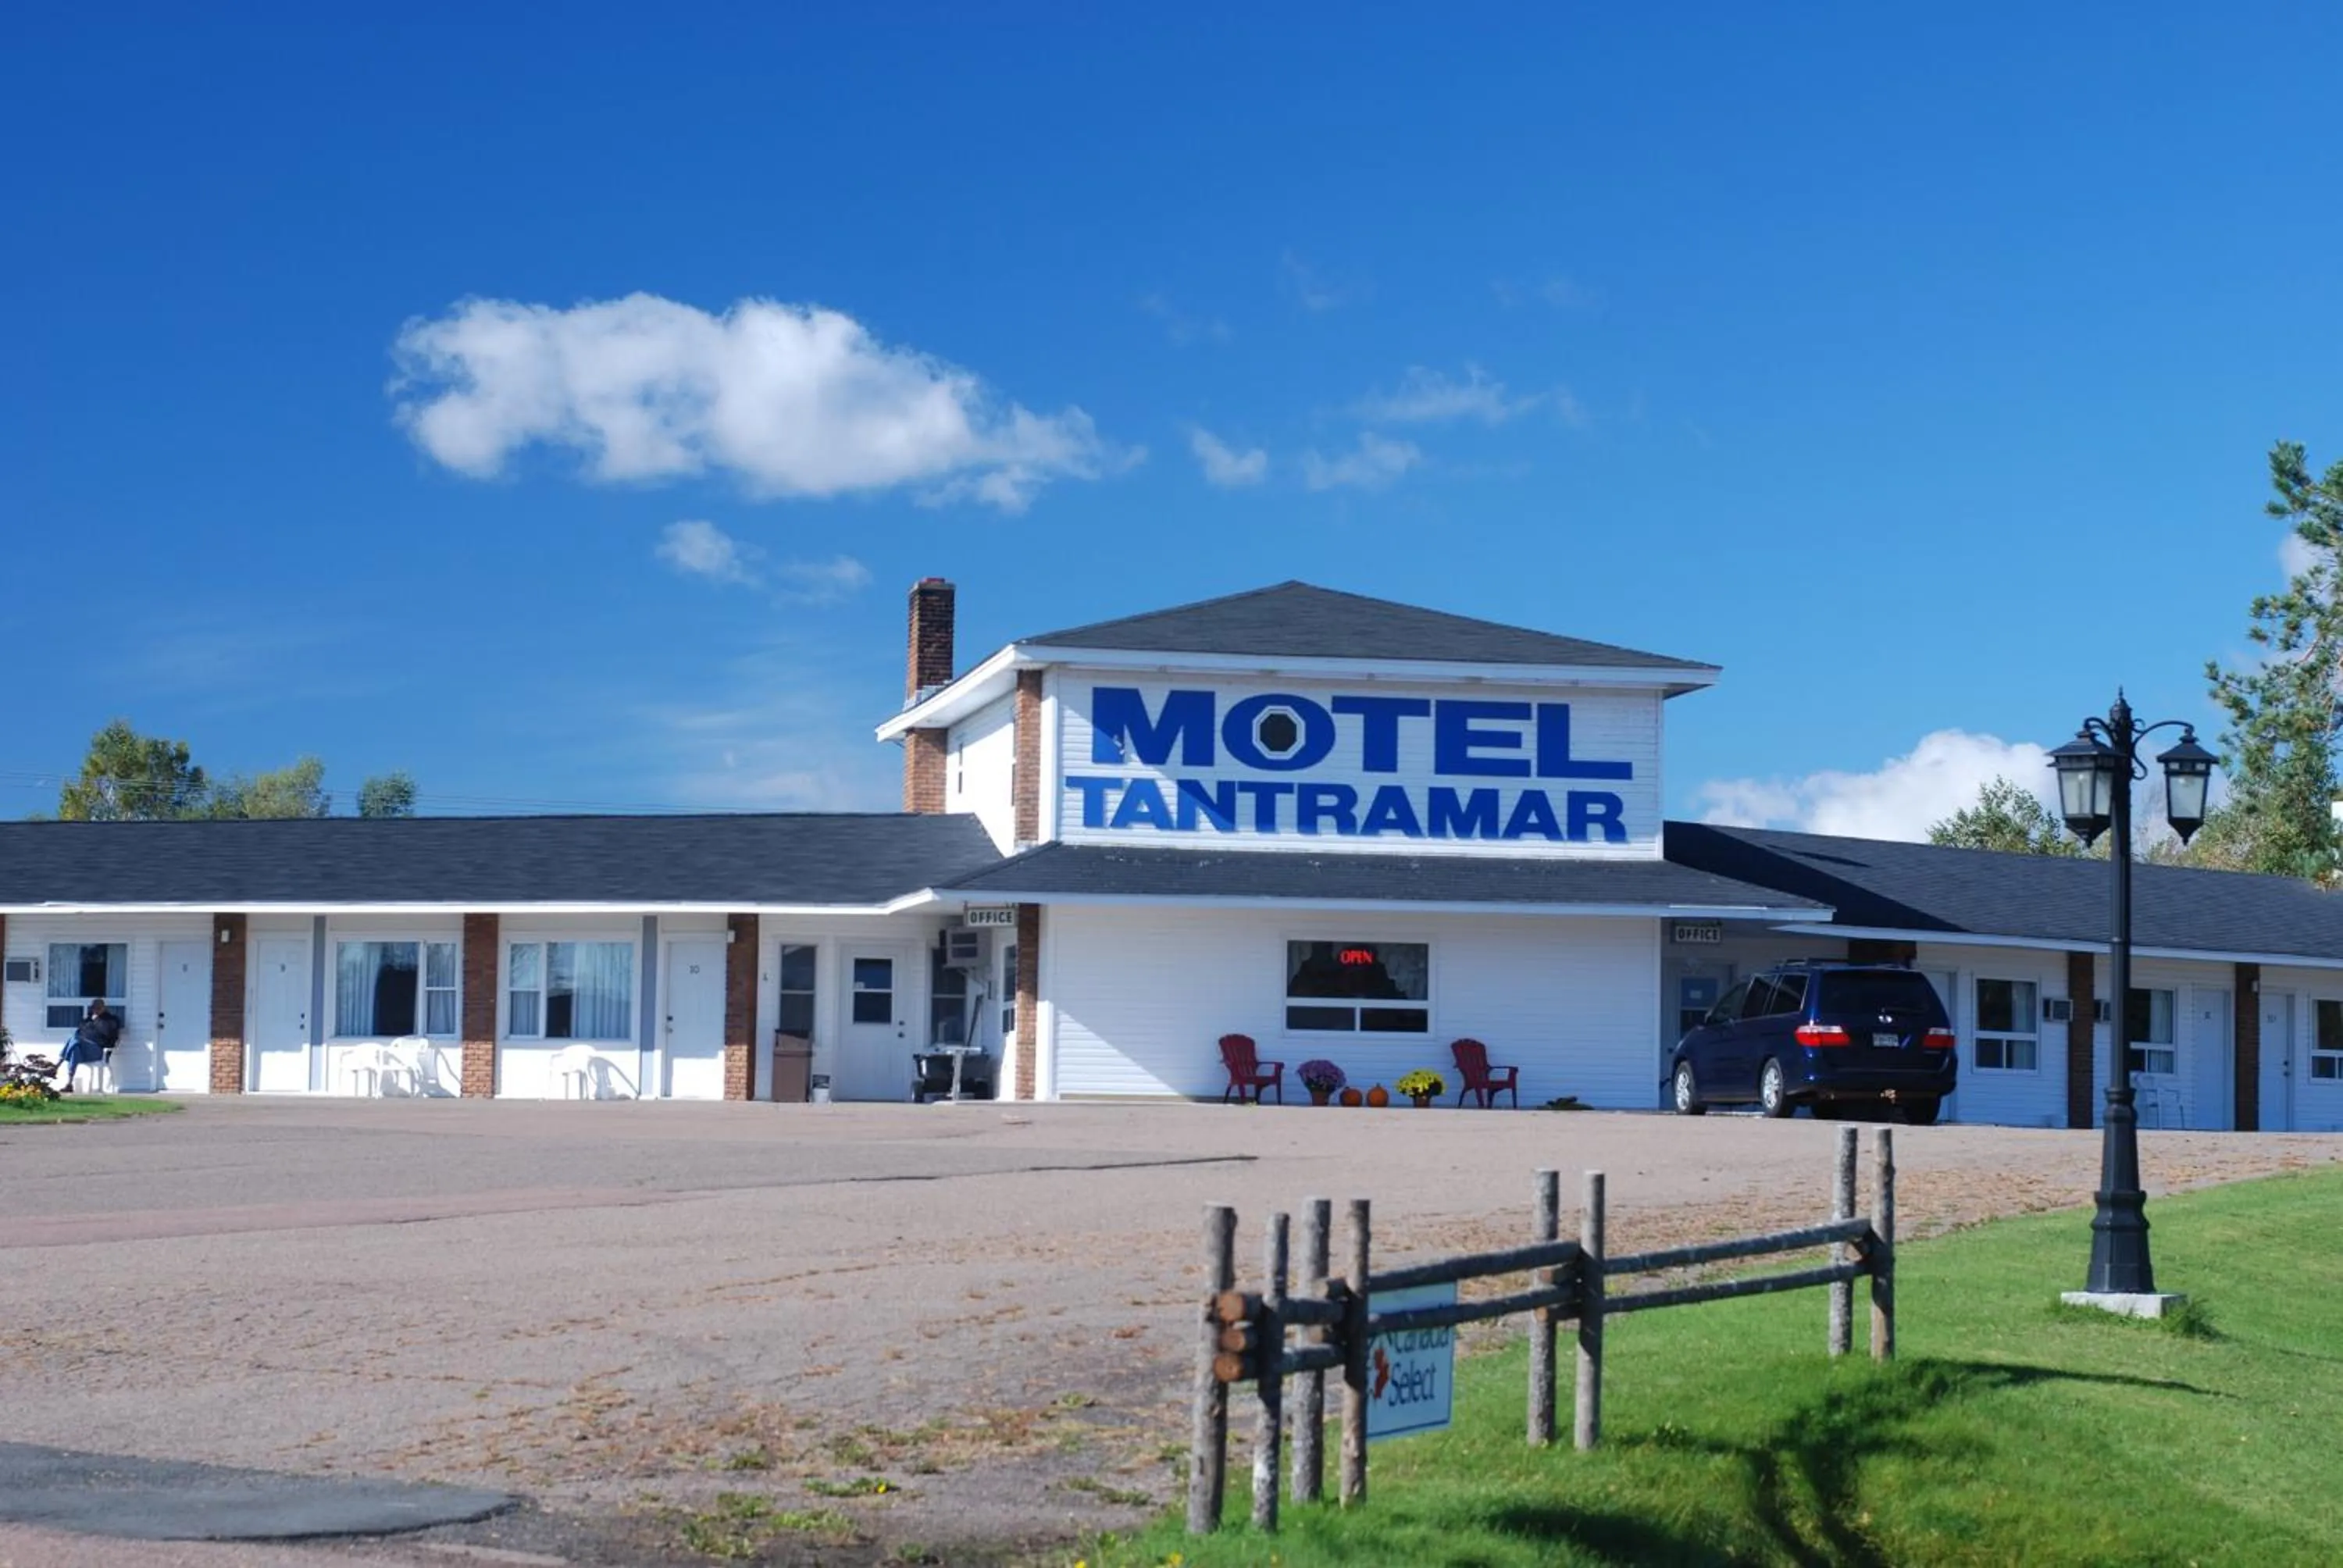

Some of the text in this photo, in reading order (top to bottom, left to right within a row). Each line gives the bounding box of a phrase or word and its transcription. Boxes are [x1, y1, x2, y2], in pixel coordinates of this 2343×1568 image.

[1092, 687, 1633, 780] MOTEL
[1065, 775, 1628, 843] TANTRAMAR
[970, 911, 1013, 924] OFFICE
[1678, 928, 1718, 940] OFFICE
[1339, 949, 1373, 964] OPEN
[1388, 1360, 1437, 1407] Select
